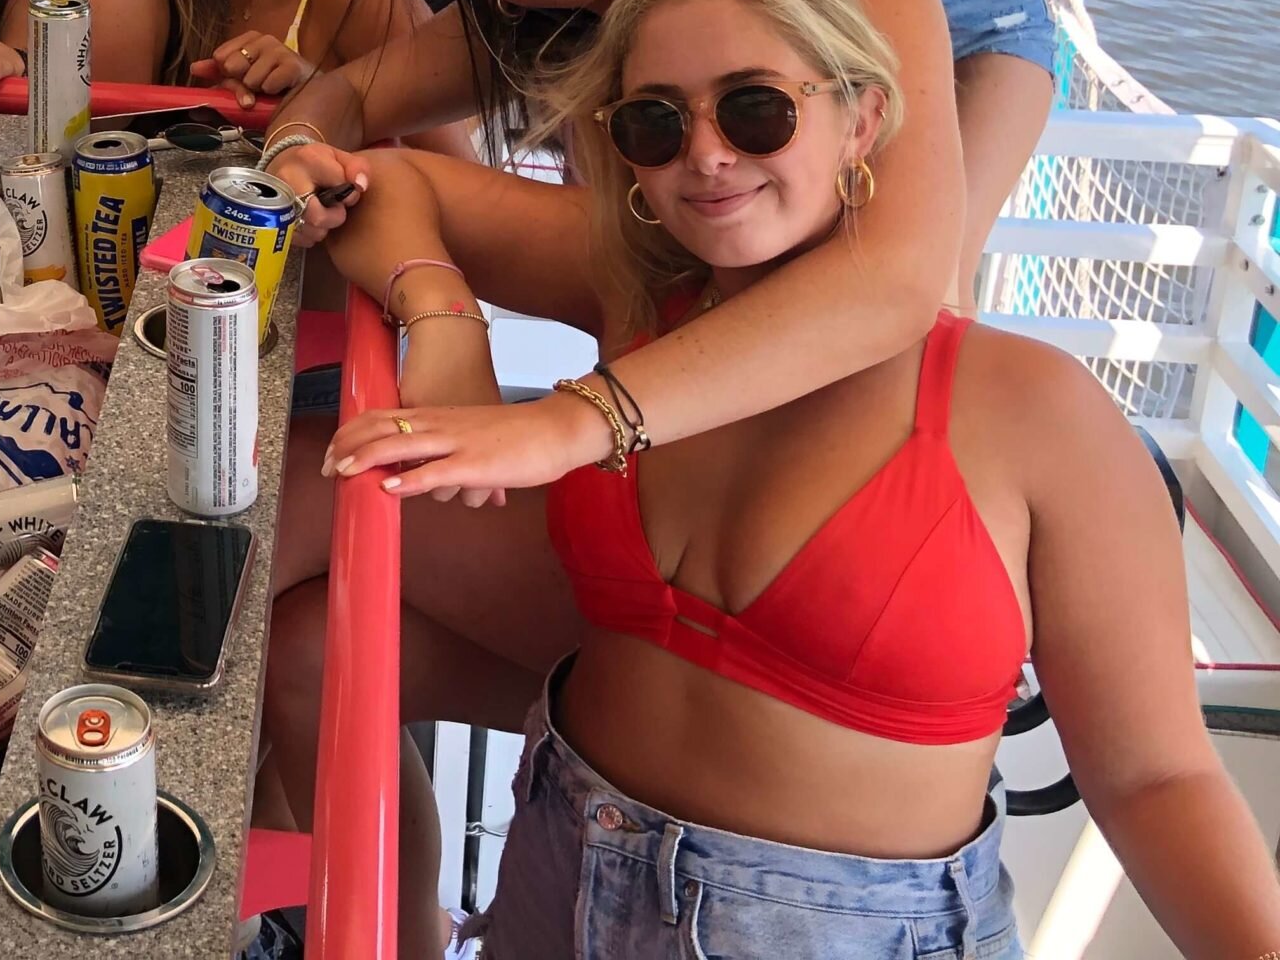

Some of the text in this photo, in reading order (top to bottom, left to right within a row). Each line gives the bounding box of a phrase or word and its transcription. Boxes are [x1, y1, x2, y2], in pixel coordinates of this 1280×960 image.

[76, 28, 91, 71] WHIT
[5, 187, 41, 210] CLAW
[91, 196, 125, 236] TEA
[211, 224, 256, 245] TWISTED
[94, 238, 126, 330] TWISTED
[180, 382, 196, 394] 100
[9, 516, 64, 544] WHITE
[3, 592, 22, 609] MADE
[23, 619, 40, 637] Facts
[14, 644, 29, 659] 100
[47, 778, 113, 826] CLAW
[42, 839, 117, 892] ARD SELTZER
